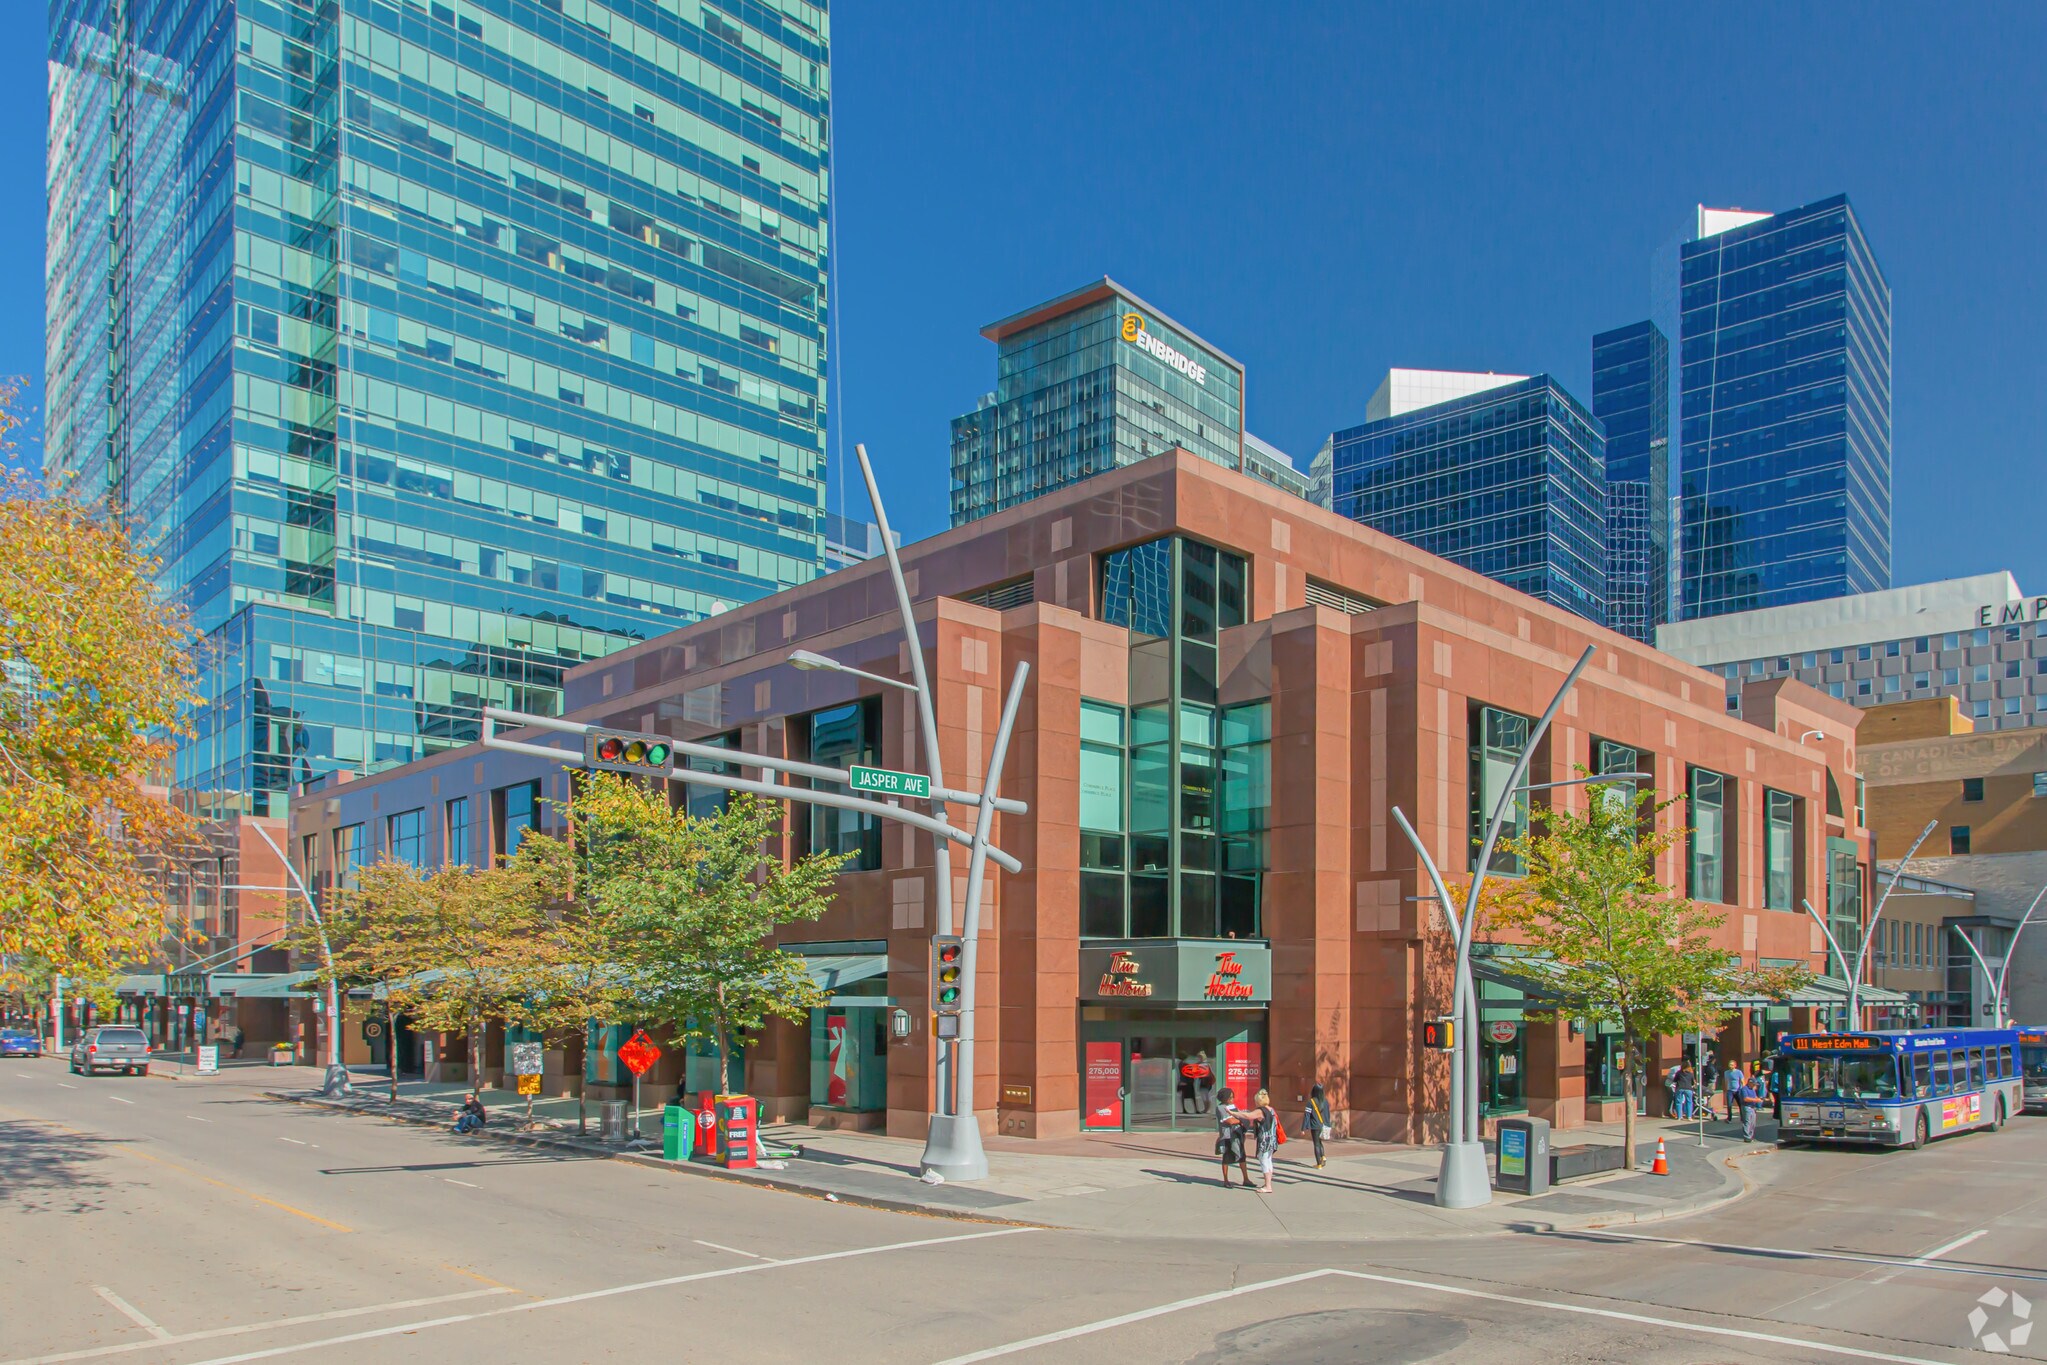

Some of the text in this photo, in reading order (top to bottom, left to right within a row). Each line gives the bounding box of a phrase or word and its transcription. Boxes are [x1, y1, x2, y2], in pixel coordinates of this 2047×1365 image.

[1136, 328, 1206, 385] ENBRIDGE
[1880, 742, 1979, 763] CANADIAN
[859, 771, 923, 793] JASPER AVE
[1110, 951, 1138, 974] Tim
[1218, 952, 1243, 975] Tim
[1098, 974, 1151, 997] Hortons
[1206, 974, 1253, 997] Hortons
[1797, 1038, 1869, 1049] 111 West Edm Mall
[1088, 1067, 1119, 1075] 275,000
[1228, 1068, 1259, 1076] 275,000
[1829, 1111, 1844, 1119] ETS
[729, 1130, 747, 1138] FREE
